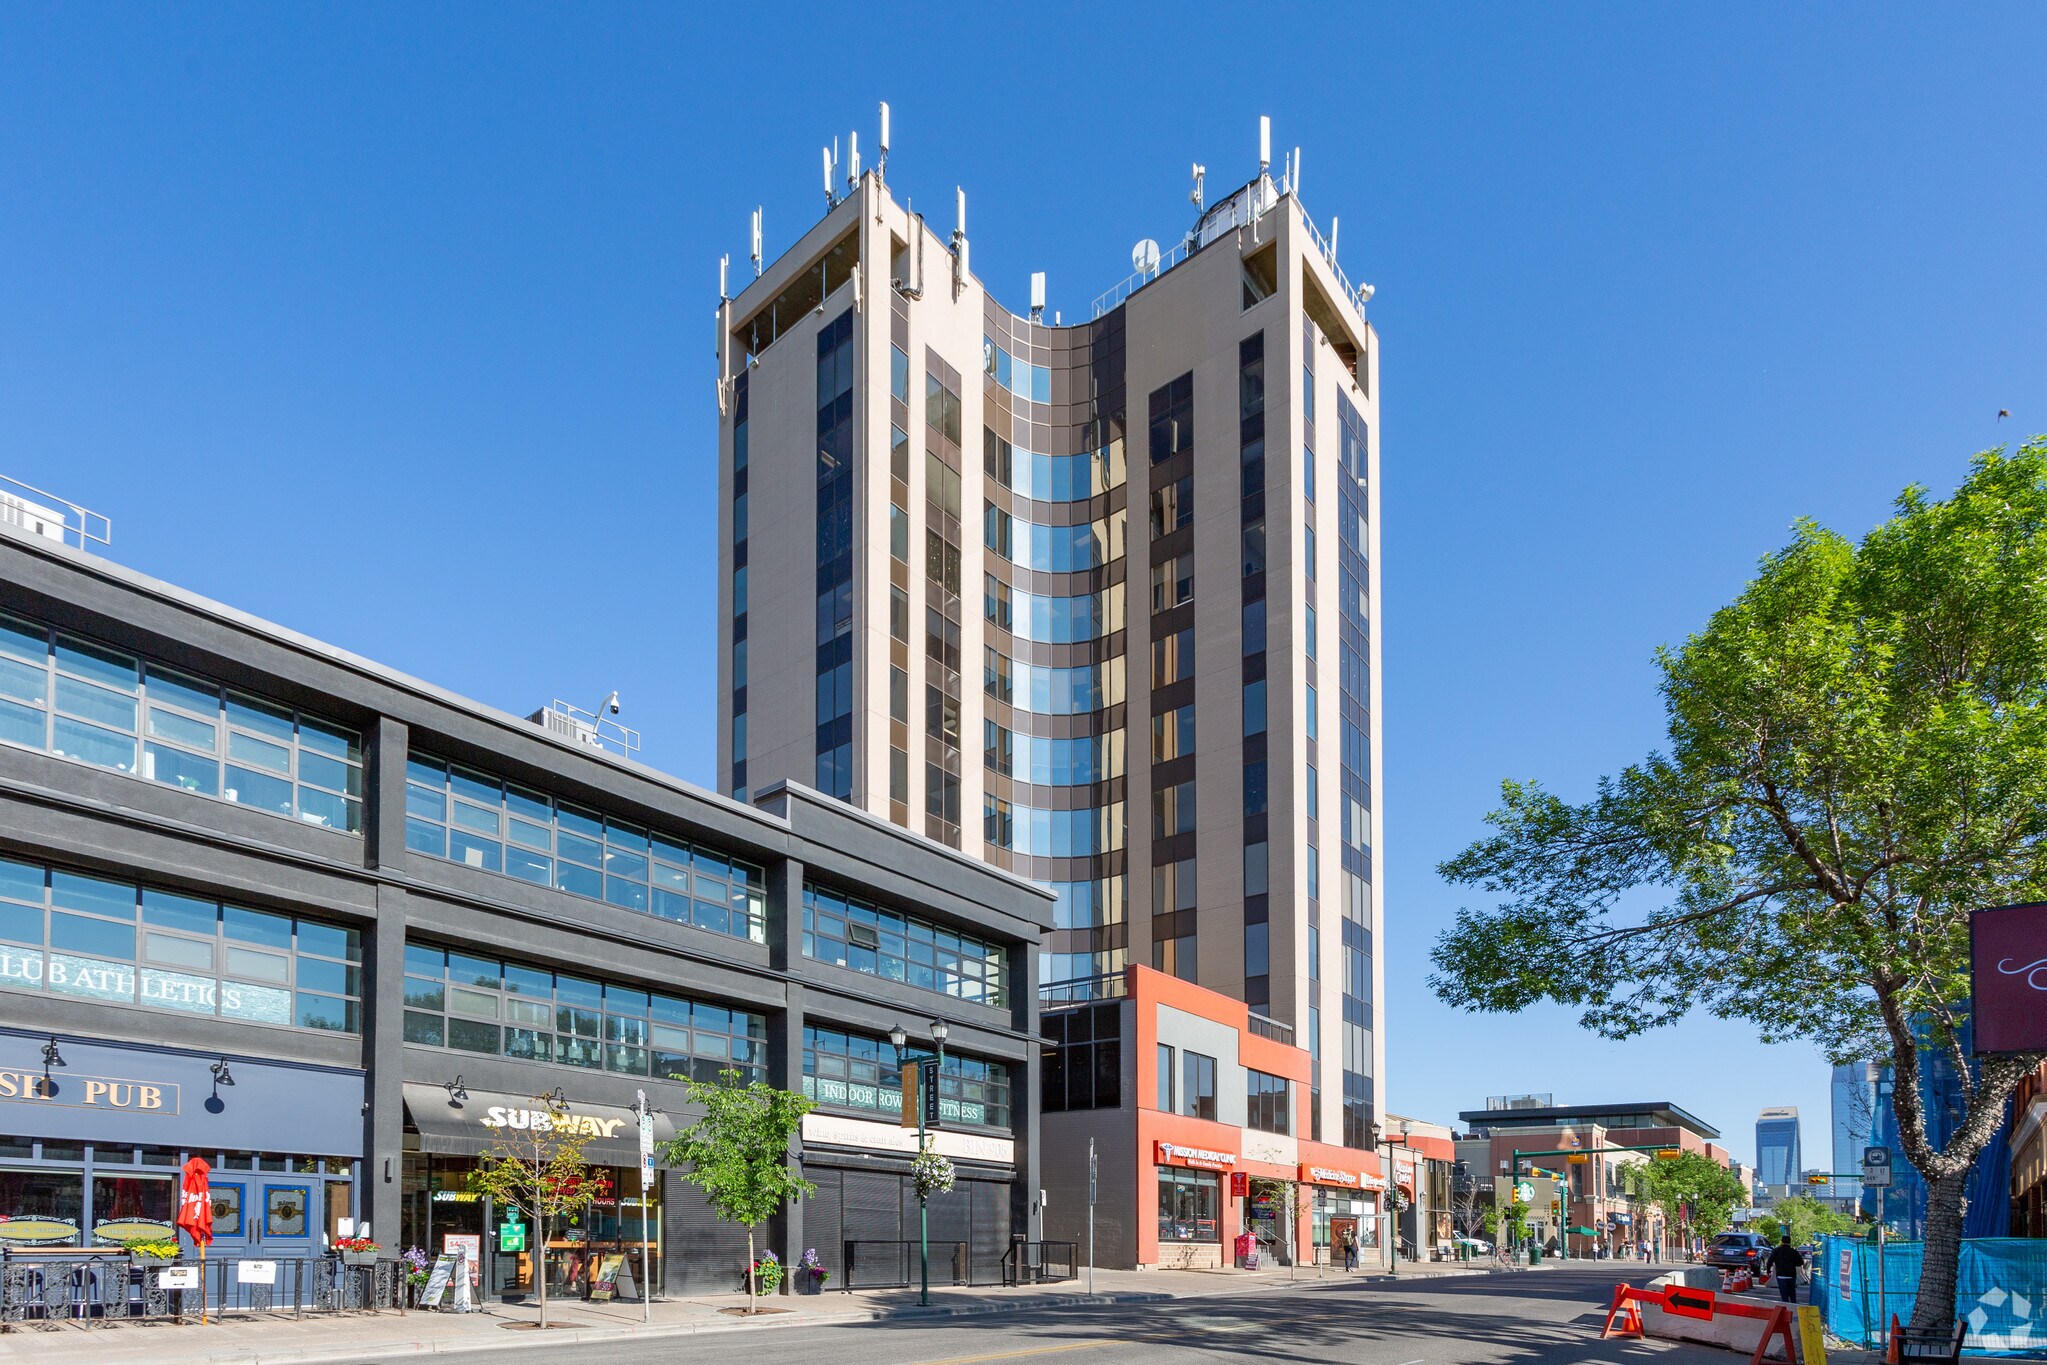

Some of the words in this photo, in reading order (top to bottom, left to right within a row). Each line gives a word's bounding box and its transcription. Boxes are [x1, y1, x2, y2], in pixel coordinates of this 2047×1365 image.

[72, 967, 241, 1009] ATHLETICS
[83, 1080, 162, 1109] PUB
[824, 1084, 873, 1103] INDOOR
[479, 1106, 627, 1138] SUBWAY
[963, 1138, 985, 1156] BIN
[1173, 1145, 1197, 1160] MISSION
[433, 1190, 478, 1202] SUBWAY
[592, 1197, 616, 1206] HOURS
[600, 1189, 609, 1197] 24
